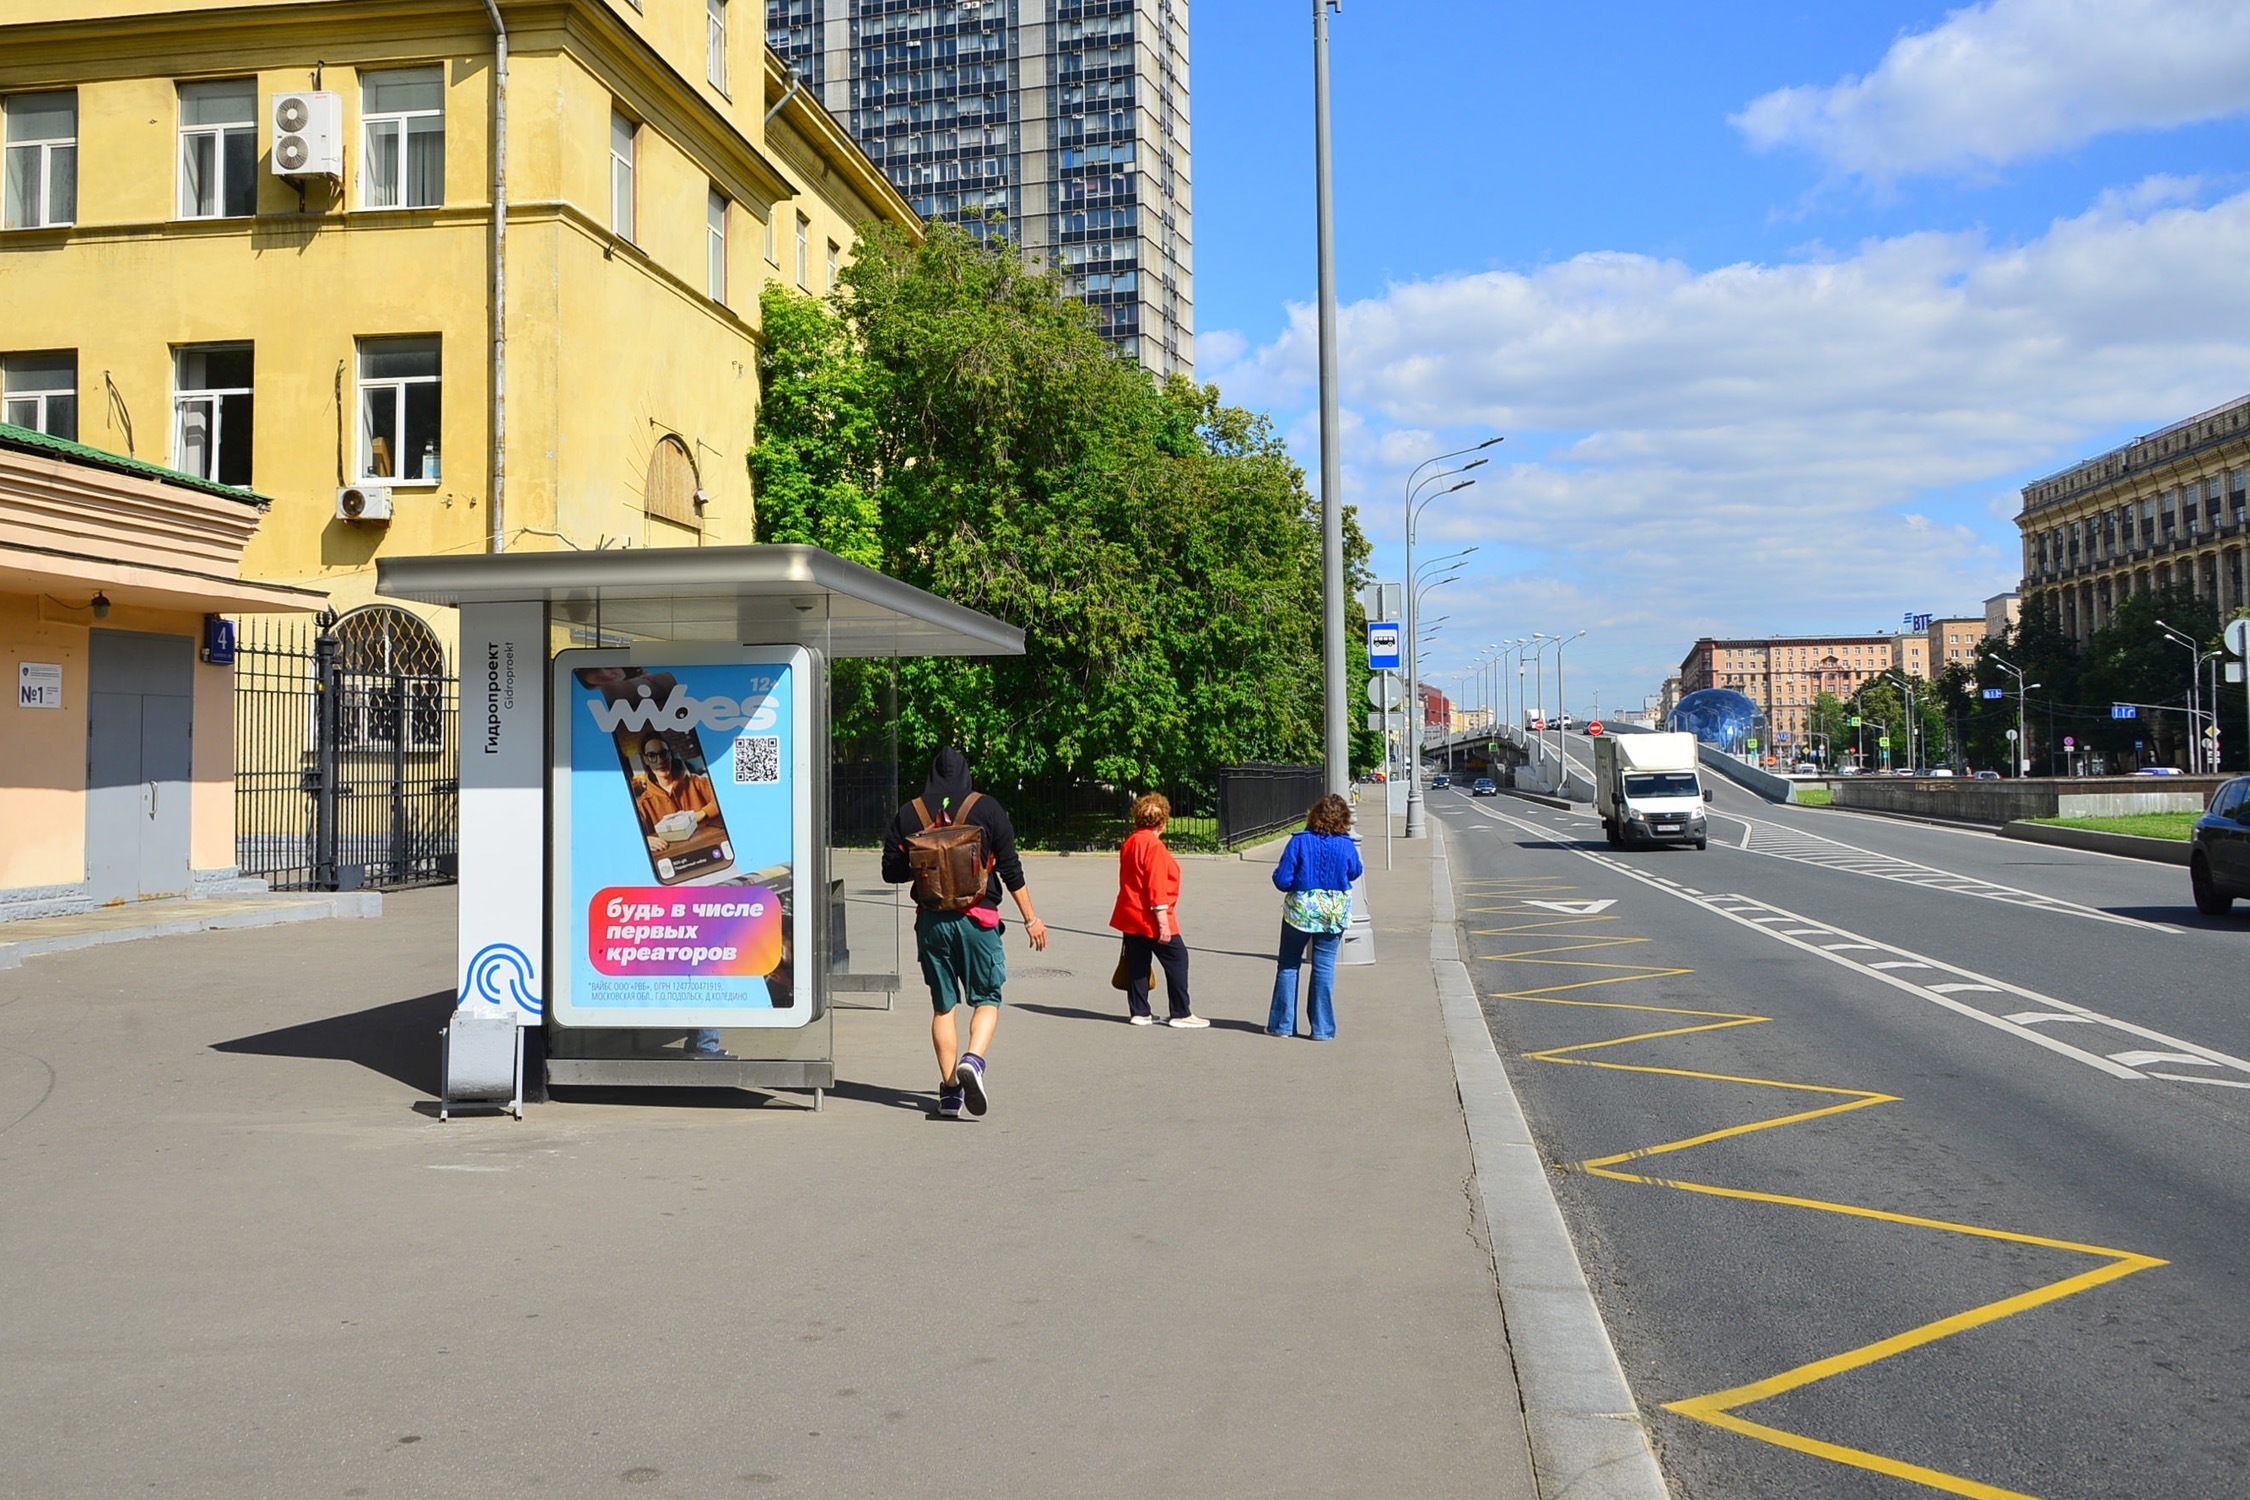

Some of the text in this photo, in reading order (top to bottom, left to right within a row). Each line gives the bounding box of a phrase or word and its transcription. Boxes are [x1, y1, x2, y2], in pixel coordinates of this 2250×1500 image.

[217, 627, 227, 650] 4
[504, 642, 516, 709] Gidroproekt
[750, 677, 779, 692] 12+
[484, 642, 501, 754] Гидропроект
[606, 897, 764, 923] будь в числе
[606, 925, 699, 945] первых
[606, 946, 737, 966] креаторов
[591, 992, 635, 1001] МОСКОВСКАЯ
[654, 982, 671, 991] ОГРН
